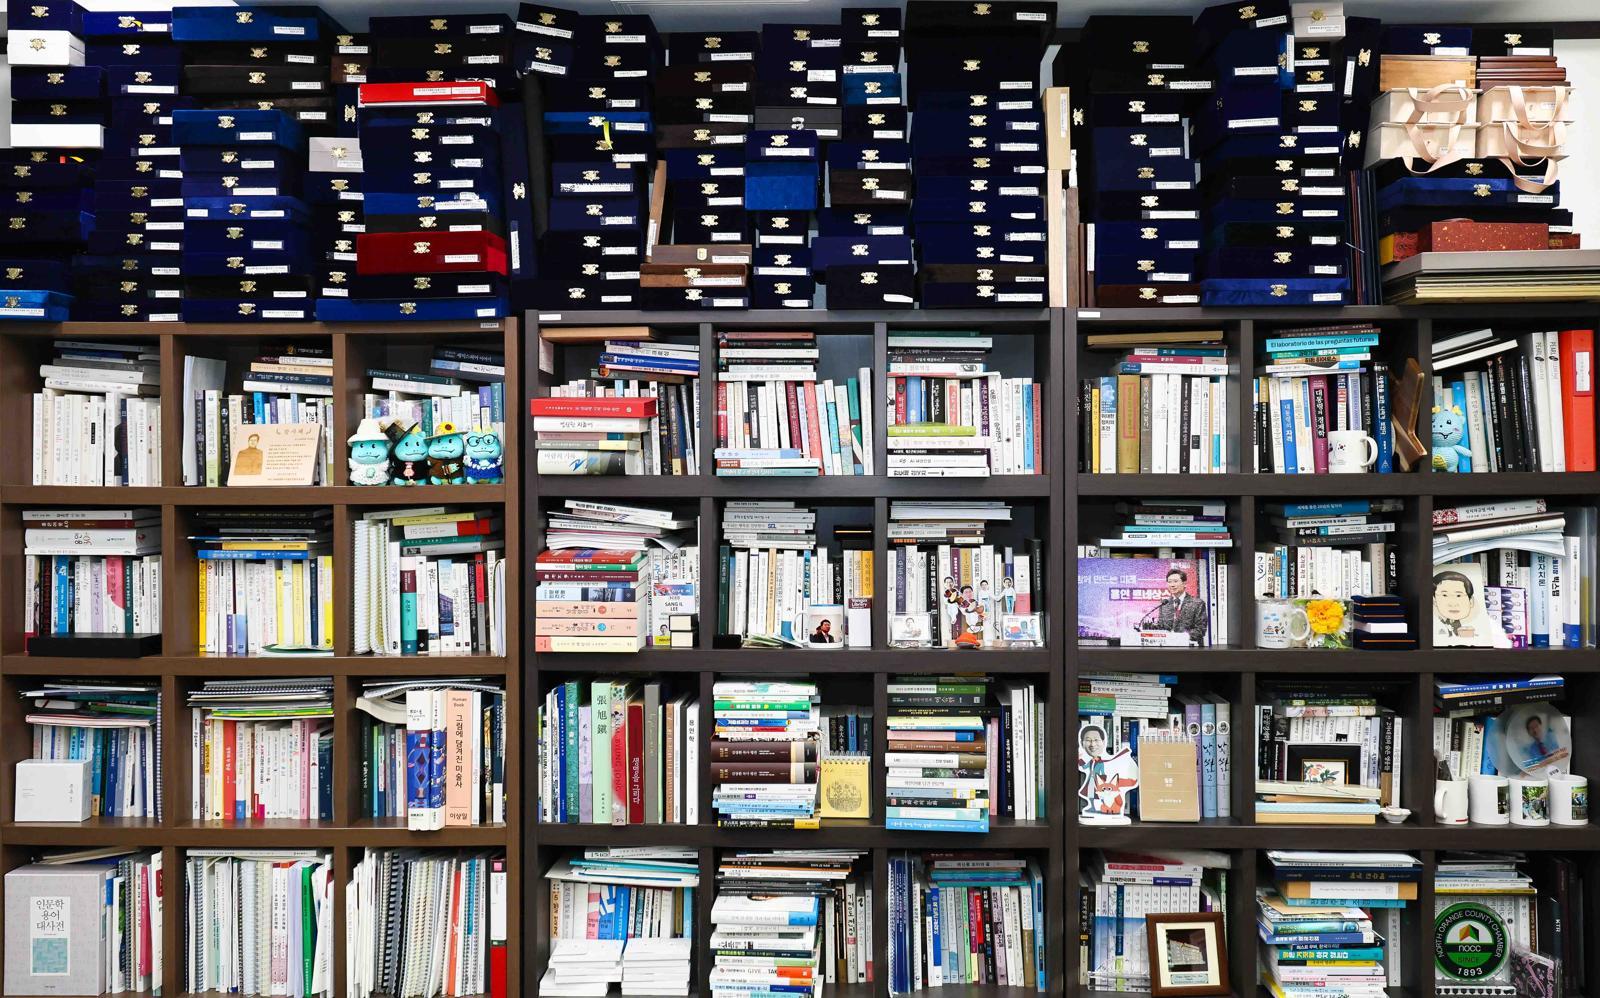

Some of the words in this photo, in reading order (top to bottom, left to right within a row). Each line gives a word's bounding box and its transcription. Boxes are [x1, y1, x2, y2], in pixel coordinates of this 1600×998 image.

[1324, 338, 1352, 346] preguntas
[1504, 551, 1513, 569] 한국
[1552, 576, 1560, 596] 빅스텝
[455, 715, 464, 737] 그림에
[455, 740, 464, 764] 담겨진
[455, 765, 464, 788] 미술사
[36, 899, 64, 910] 인문학
[41, 910, 60, 920] 용어
[1438, 910, 1464, 933] ORANGE
[1464, 910, 1492, 925] COUNTY
[36, 921, 64, 931] 대사전
[1435, 933, 1444, 958] NORTH
[1491, 923, 1504, 958] CHAMBER
[1458, 968, 1483, 976] 1893
